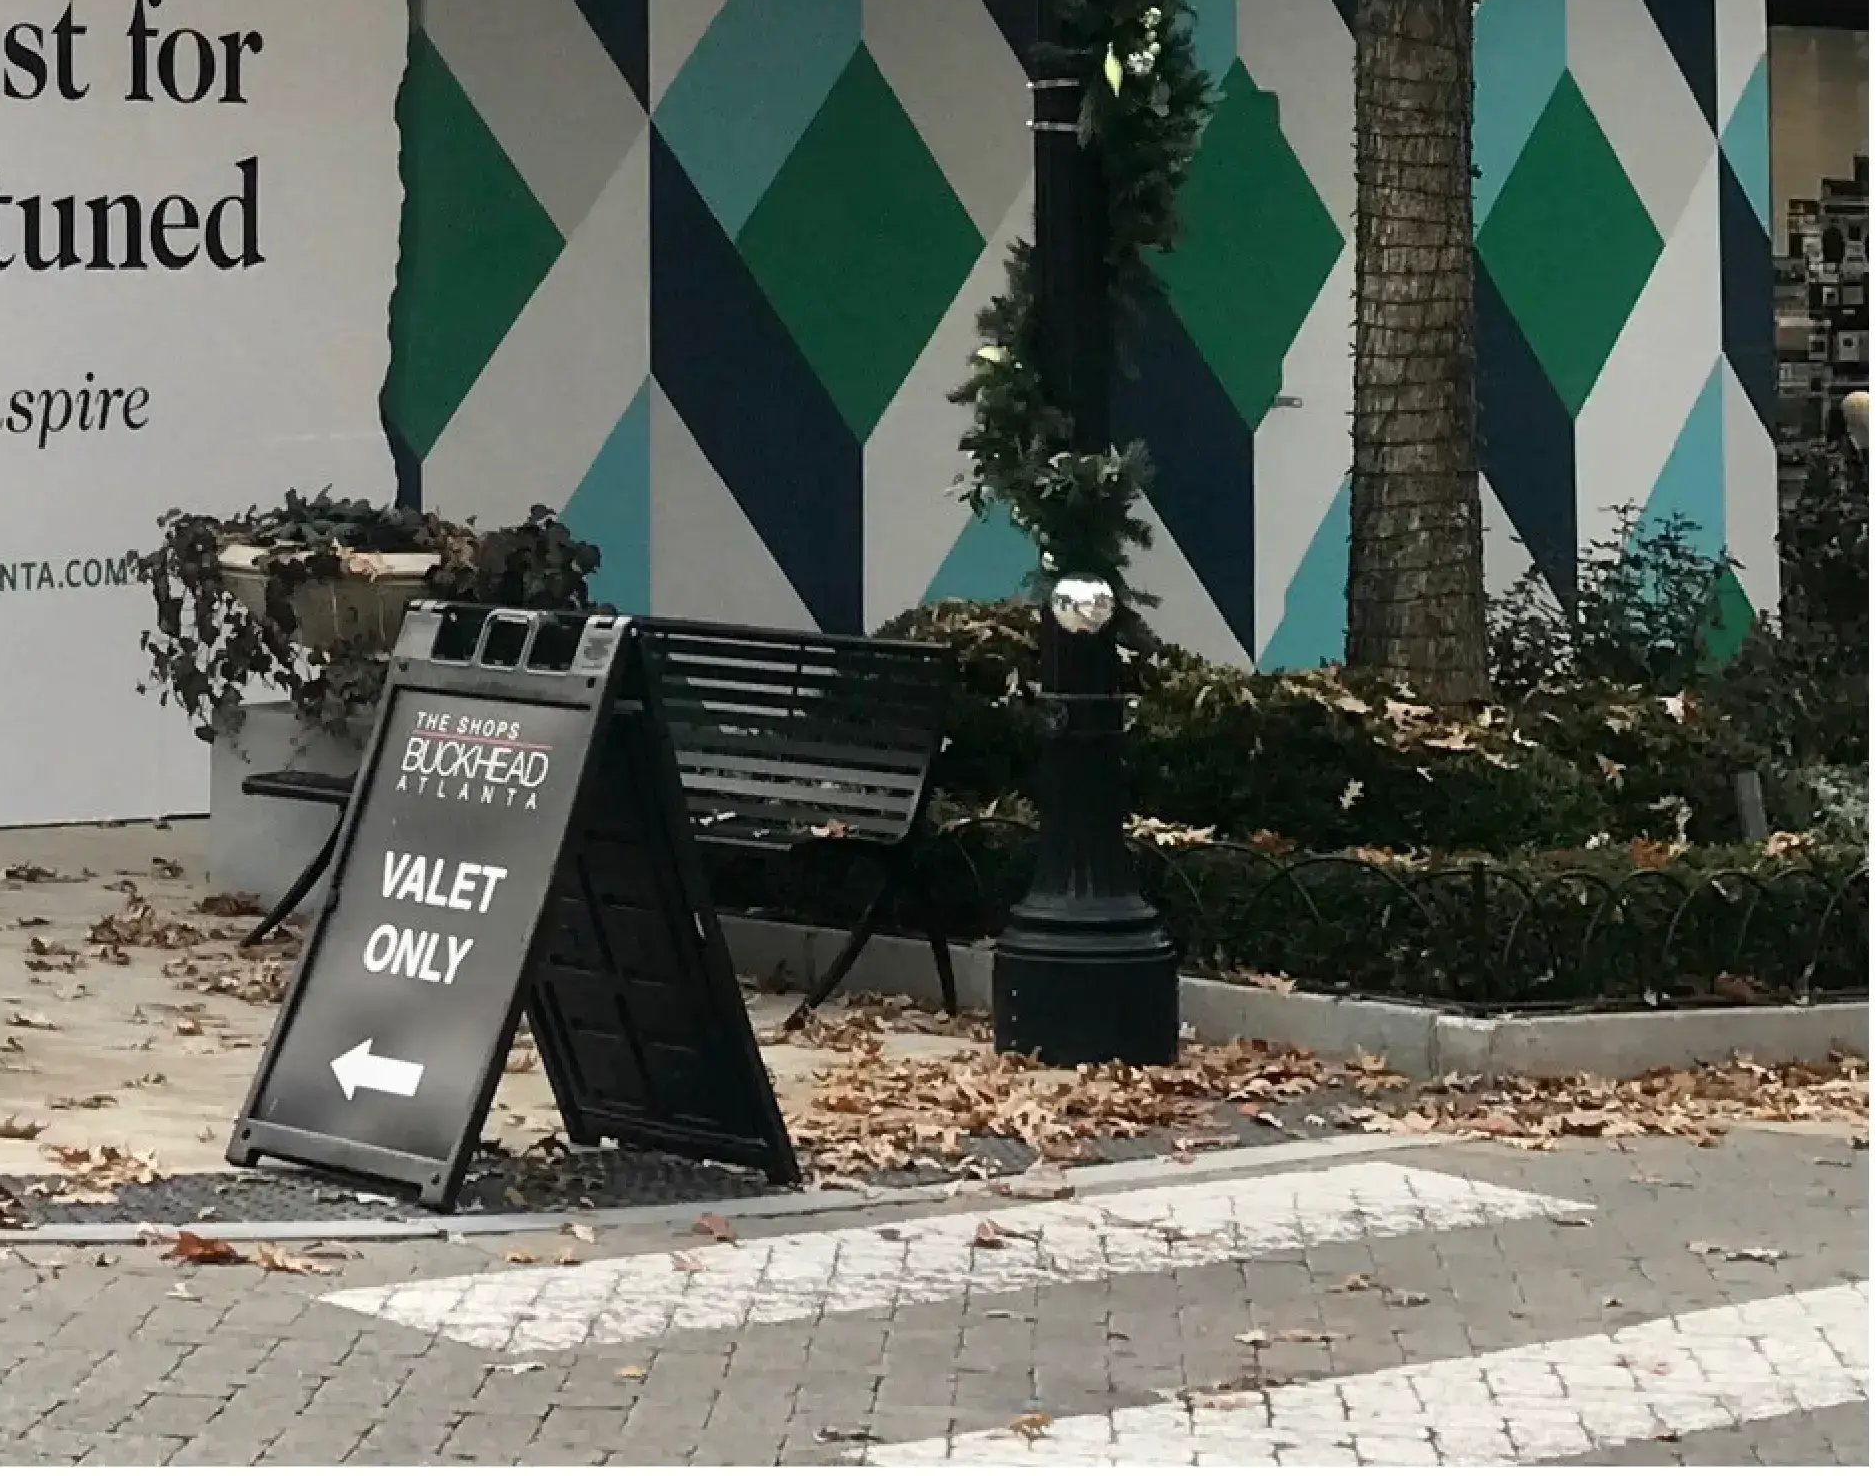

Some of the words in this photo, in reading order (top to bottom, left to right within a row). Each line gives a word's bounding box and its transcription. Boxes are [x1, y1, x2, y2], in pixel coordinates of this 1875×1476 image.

[415, 711, 451, 732] THE
[457, 715, 522, 741] SHOPS
[400, 736, 550, 788] BUCKHEAD
[395, 774, 537, 811] ATLANTA
[381, 850, 508, 914] VALET
[362, 924, 475, 985] ONLY
